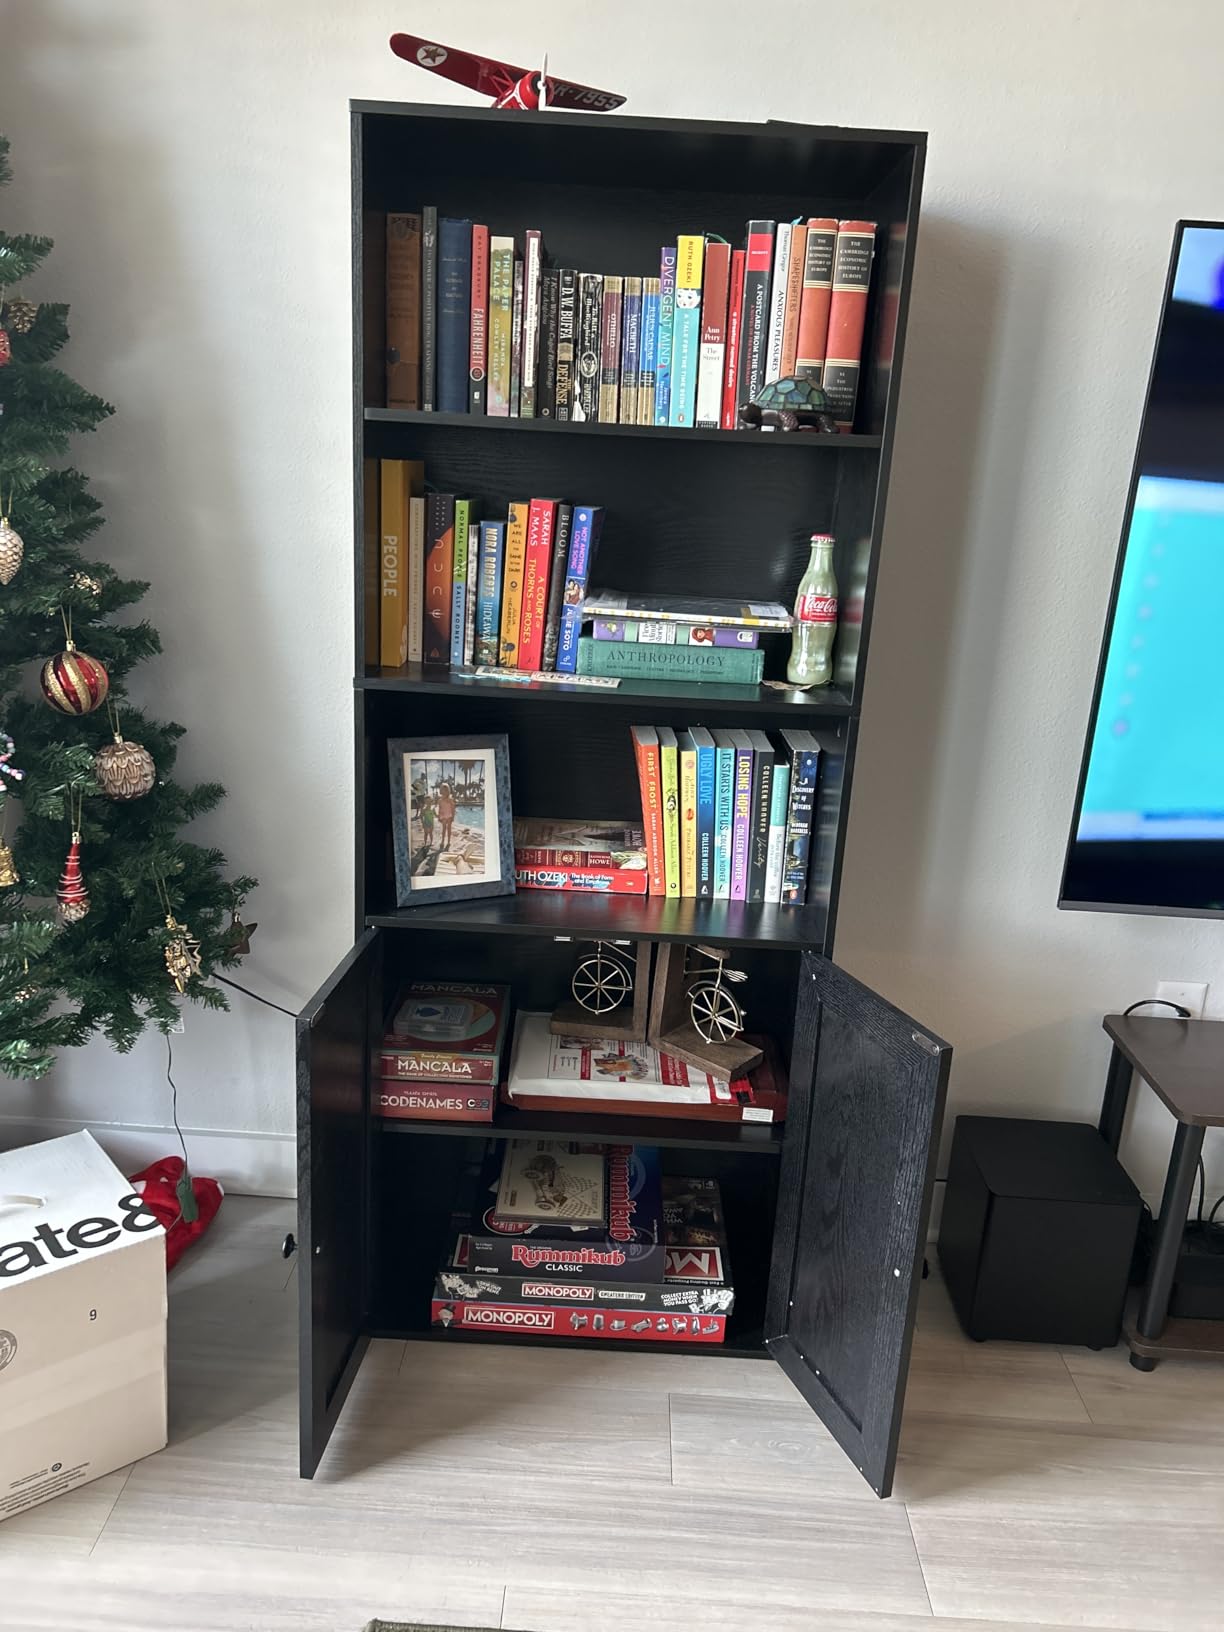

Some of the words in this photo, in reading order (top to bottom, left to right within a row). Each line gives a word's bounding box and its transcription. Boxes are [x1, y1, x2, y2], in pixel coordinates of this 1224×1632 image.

[502, 254, 510, 274] THE
[501, 280, 509, 311] PAPER
[562, 288, 573, 296] D.
[662, 256, 675, 329] DIVERGENT
[789, 257, 800, 312] SHAPESHIFTERS
[561, 297, 573, 309] W.
[775, 291, 784, 327] ANXIOUS
[560, 311, 572, 339] BUFFA
[648, 306, 657, 330] JULIUS
[472, 308, 484, 365] FAHRENHEIT
[629, 314, 637, 353] MACBETH
[705, 334, 720, 342] Petry
[661, 332, 672, 365] MIND
[772, 329, 781, 371] PLEASURES
[557, 364, 569, 404] DEFENSE
[749, 371, 757, 403] VOLCAN
[485, 528, 498, 553] NORA
[530, 517, 539, 546] MAAS
[541, 510, 551, 545] SARAH
[557, 514, 569, 557] BLOOM
[573, 531, 581, 549] LOVE
[384, 536, 397, 597] PEOPLE
[576, 543, 586, 575] ANOTHER
[483, 557, 497, 597] ROBERTS
[527, 558, 537, 598] THORNS
[535, 587, 544, 620] COURT
[482, 602, 494, 644] HIDEAWAY
[523, 612, 532, 643] ROSES
[563, 626, 571, 651] SOTO
[607, 650, 726, 666] ANTHROPOLOGY
[647, 752, 655, 778] FIRST
[700, 754, 711, 777] UGLY
[722, 753, 731, 761] IT
[720, 764, 731, 793] STARTS
[738, 756, 750, 790] LOSING
[761, 766, 770, 799] COLLEEN
[648, 781, 656, 809] FROST
[700, 781, 712, 805] LOVE
[720, 797, 729, 817] WITH
[737, 793, 748, 818] HOPE
[720, 820, 728, 830] US
[760, 802, 768, 833] HOOVER
[701, 832, 709, 857] COLLEEN
[736, 824, 744, 853] COLLEEN
[754, 836, 766, 868] Verity
[515, 870, 536, 880] UTH
[537, 871, 568, 881] OZEKI
[735, 854, 743, 880] HOOVER
[411, 984, 497, 994] MANCALA
[398, 1060, 472, 1073] MANCALA
[381, 1095, 462, 1109] CODENAMES
[512, 1245, 625, 1268] Rummikub
[545, 1264, 583, 1272] CLASSIC
[525, 1286, 591, 1298] MONOPOLY
[468, 1310, 551, 1326] MONOPOLY
